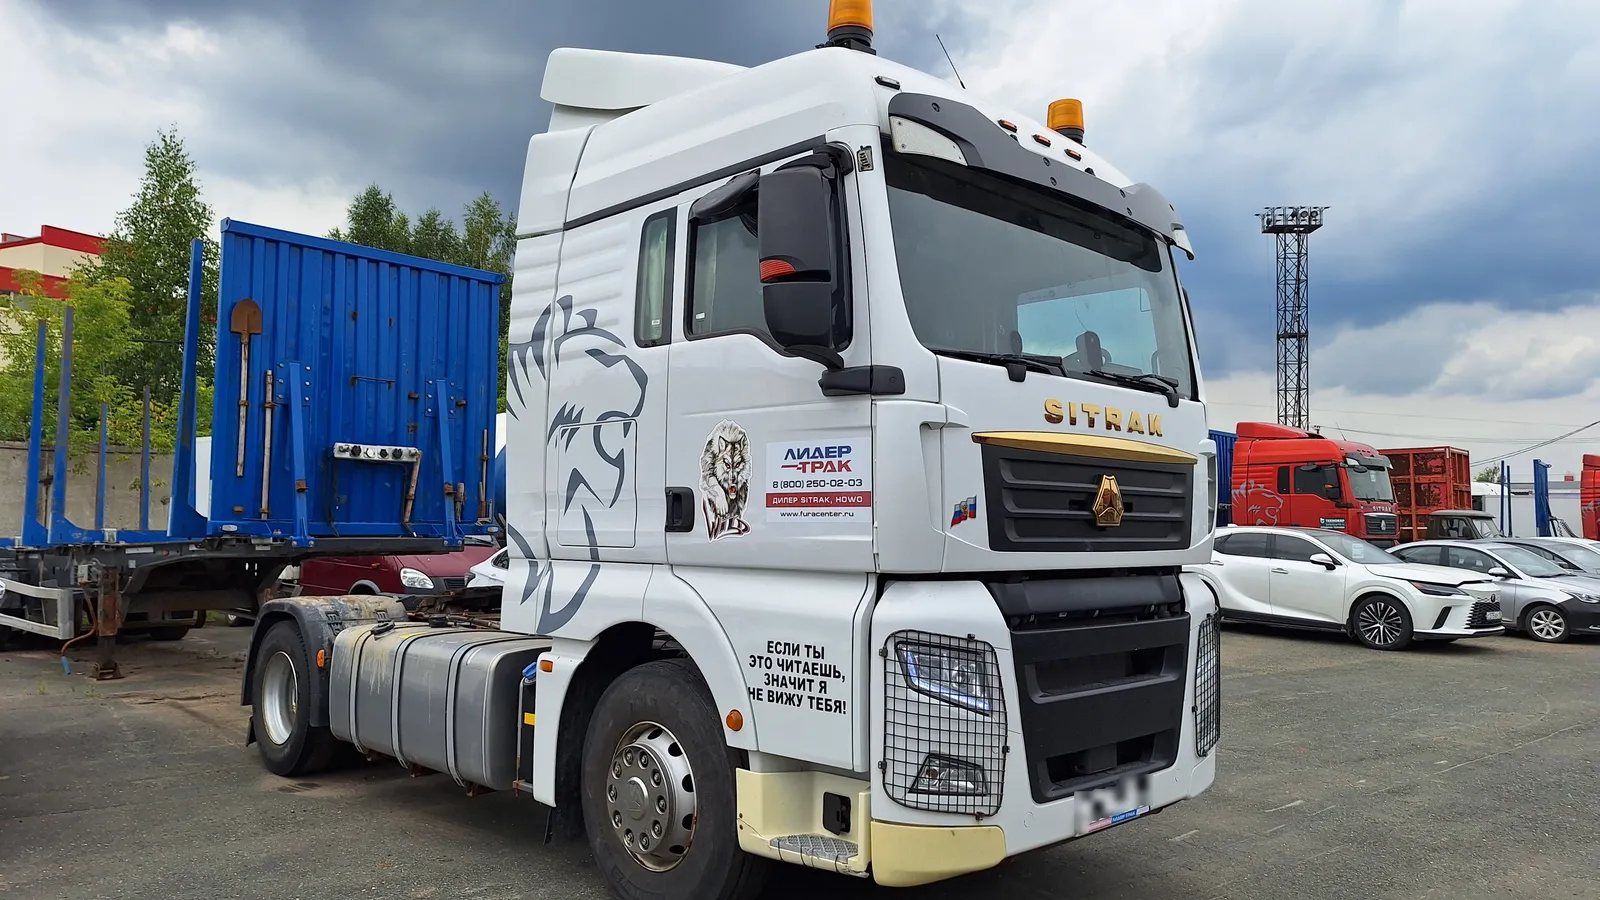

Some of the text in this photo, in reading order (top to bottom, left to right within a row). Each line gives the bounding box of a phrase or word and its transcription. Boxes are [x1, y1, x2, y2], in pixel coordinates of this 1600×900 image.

[1044, 398, 1163, 437] SITRAK
[784, 445, 852, 460] ЛИДЕР
[797, 460, 852, 473] ТРАК
[772, 479, 863, 489] 8 (800) 250-02-03
[772, 497, 798, 505] ДИЛЕР
[800, 496, 833, 504] SITRAK,
[767, 641, 825, 659] ЕСЛИ ТЫ
[749, 655, 846, 682] ЭТО ЧИТАЕШЬ,
[764, 673, 827, 694] ЗНАЧИТ Я
[748, 687, 847, 714] НЕ ВИЖУ ТЕБЯ!
